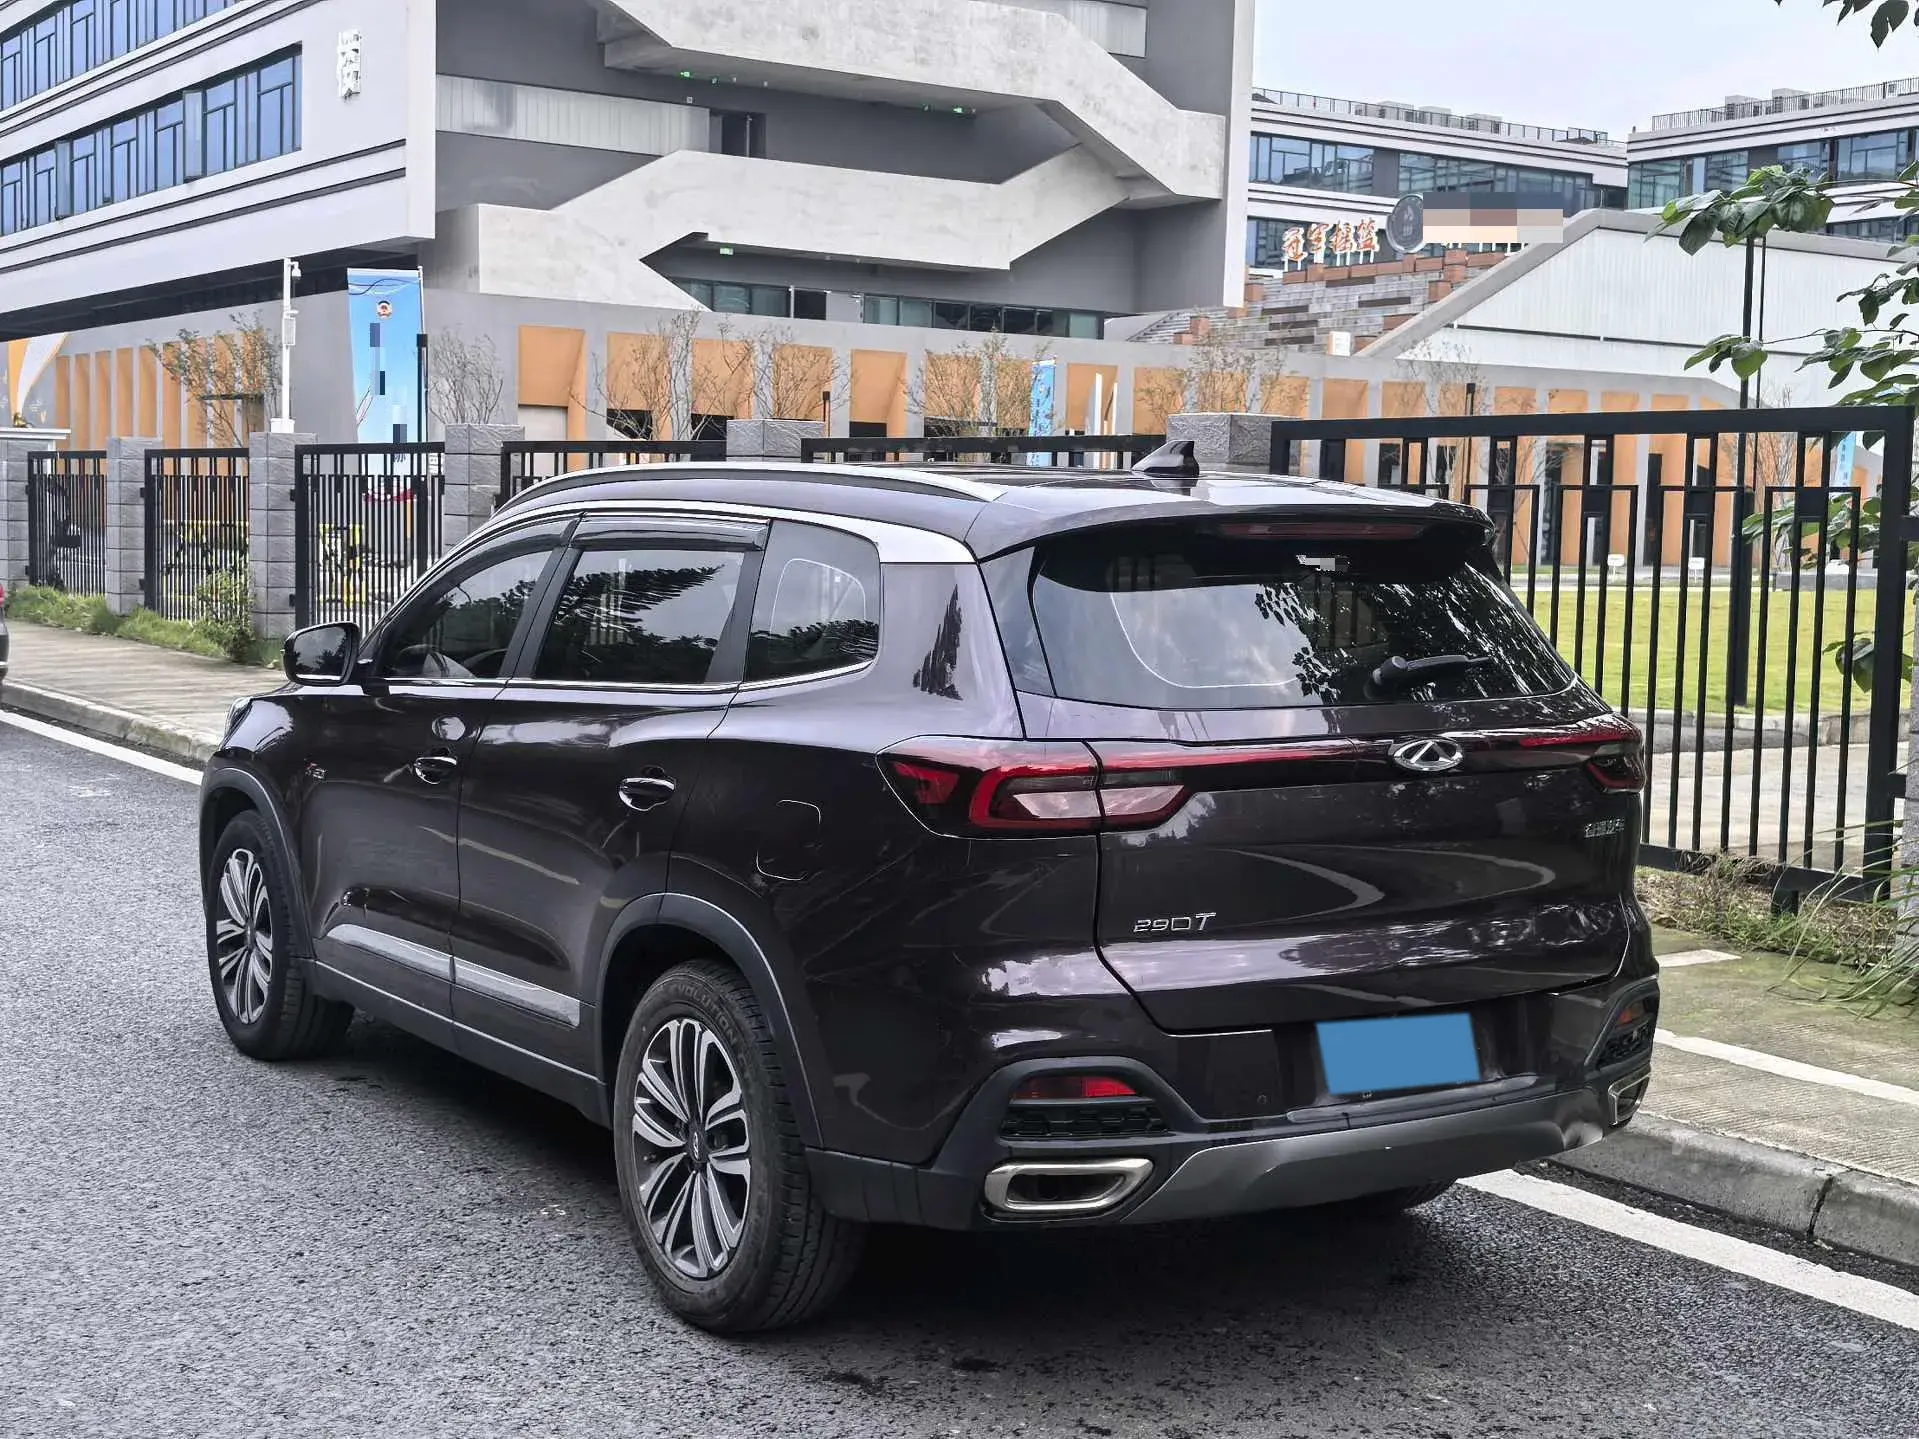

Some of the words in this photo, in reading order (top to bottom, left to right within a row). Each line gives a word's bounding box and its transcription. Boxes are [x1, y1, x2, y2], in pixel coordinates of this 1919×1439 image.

[1281, 217, 1380, 262] 冠军摇篮
[1132, 911, 1217, 933] 290T
